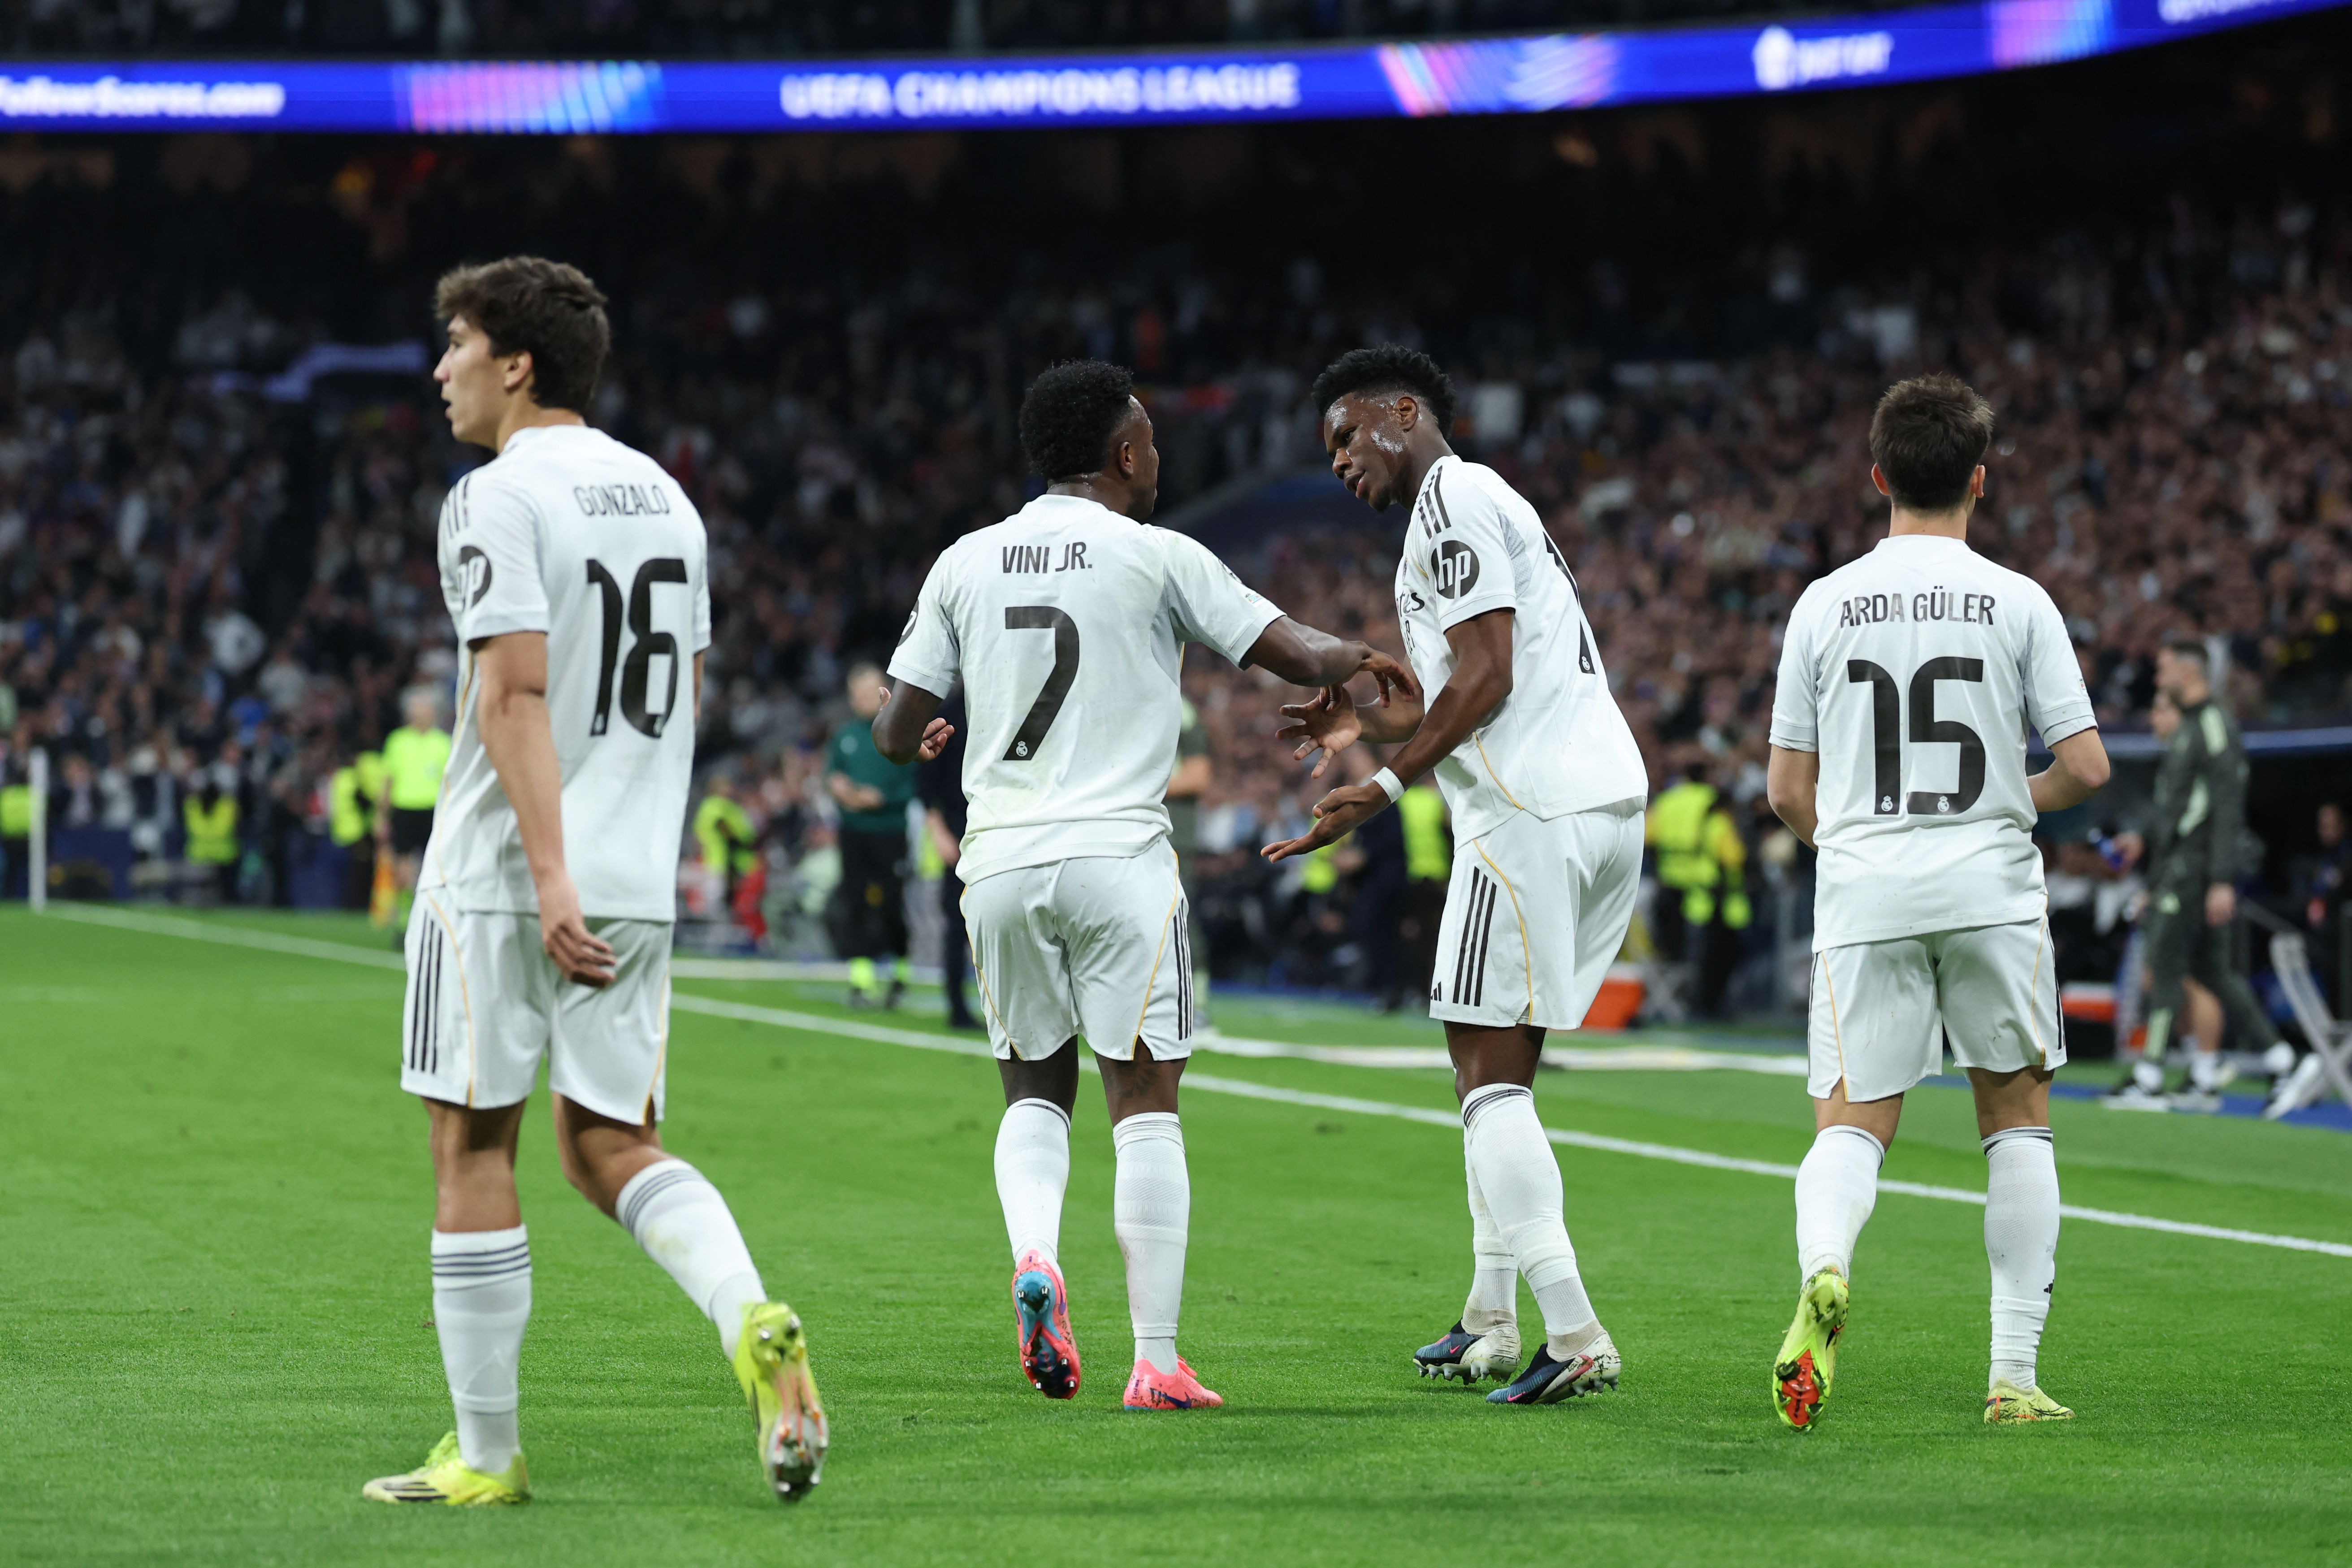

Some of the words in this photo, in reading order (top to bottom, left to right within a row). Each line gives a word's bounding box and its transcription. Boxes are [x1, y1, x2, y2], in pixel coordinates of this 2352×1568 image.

[781, 74, 891, 118] UEFA
[895, 70, 1140, 118] CHAMPIONS
[1143, 62, 1300, 112] LEAGUE
[573, 484, 669, 516] GONZALO
[1003, 546, 1050, 574] VINI
[1055, 541, 1092, 572] JR.
[1436, 541, 1472, 598] hp
[1840, 593, 1906, 628] ARDA
[1913, 585, 1995, 625] GÜLER
[586, 558, 687, 738] 16
[1003, 606, 1079, 760] 7
[1847, 656, 1986, 815] 15
